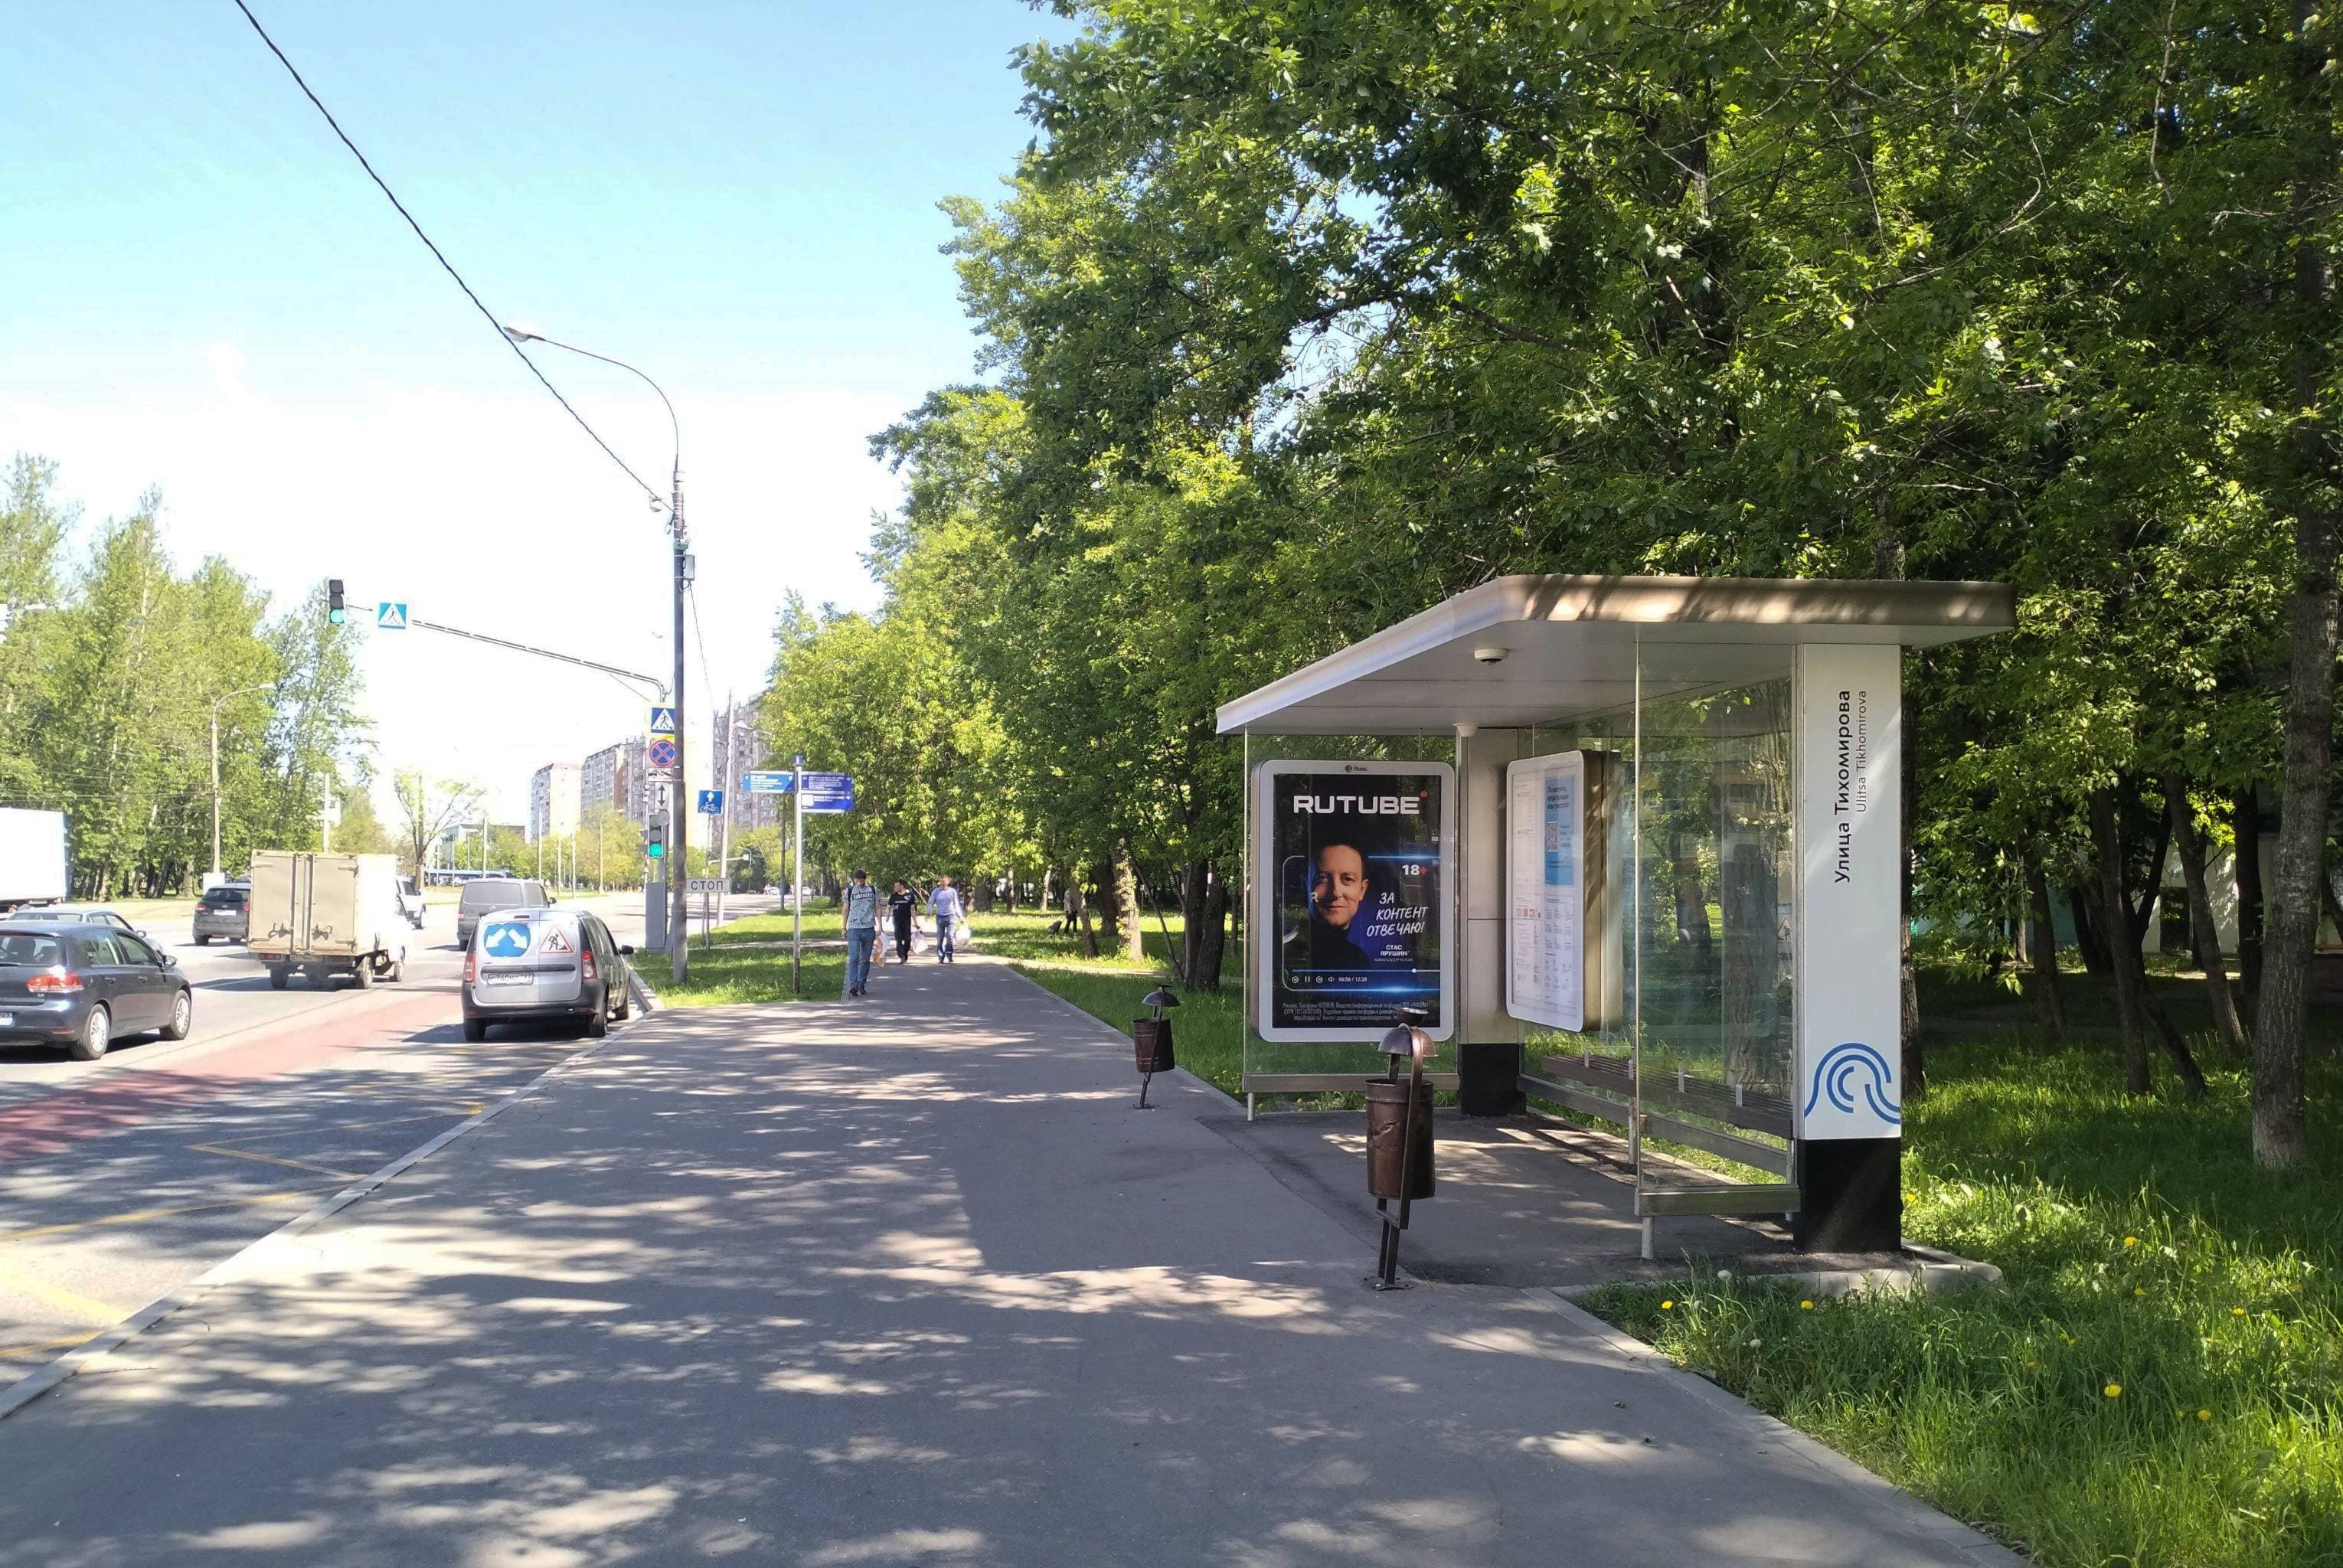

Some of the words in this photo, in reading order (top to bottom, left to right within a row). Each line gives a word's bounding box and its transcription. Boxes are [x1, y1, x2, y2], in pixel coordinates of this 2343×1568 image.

[1855, 691, 1867, 772] Tikhomirova
[1835, 690, 1853, 815] Тихомирова
[1856, 776, 1867, 812] Ulitsa
[1293, 795, 1420, 814] RUTUBE
[1835, 822, 1851, 883] Улица
[691, 880, 724, 890] СТОП
[1379, 892, 1394, 904] ЗА
[1376, 906, 1429, 920] КОНТЕНТ
[1366, 921, 1425, 937] ОТВЕЧАЮ!
